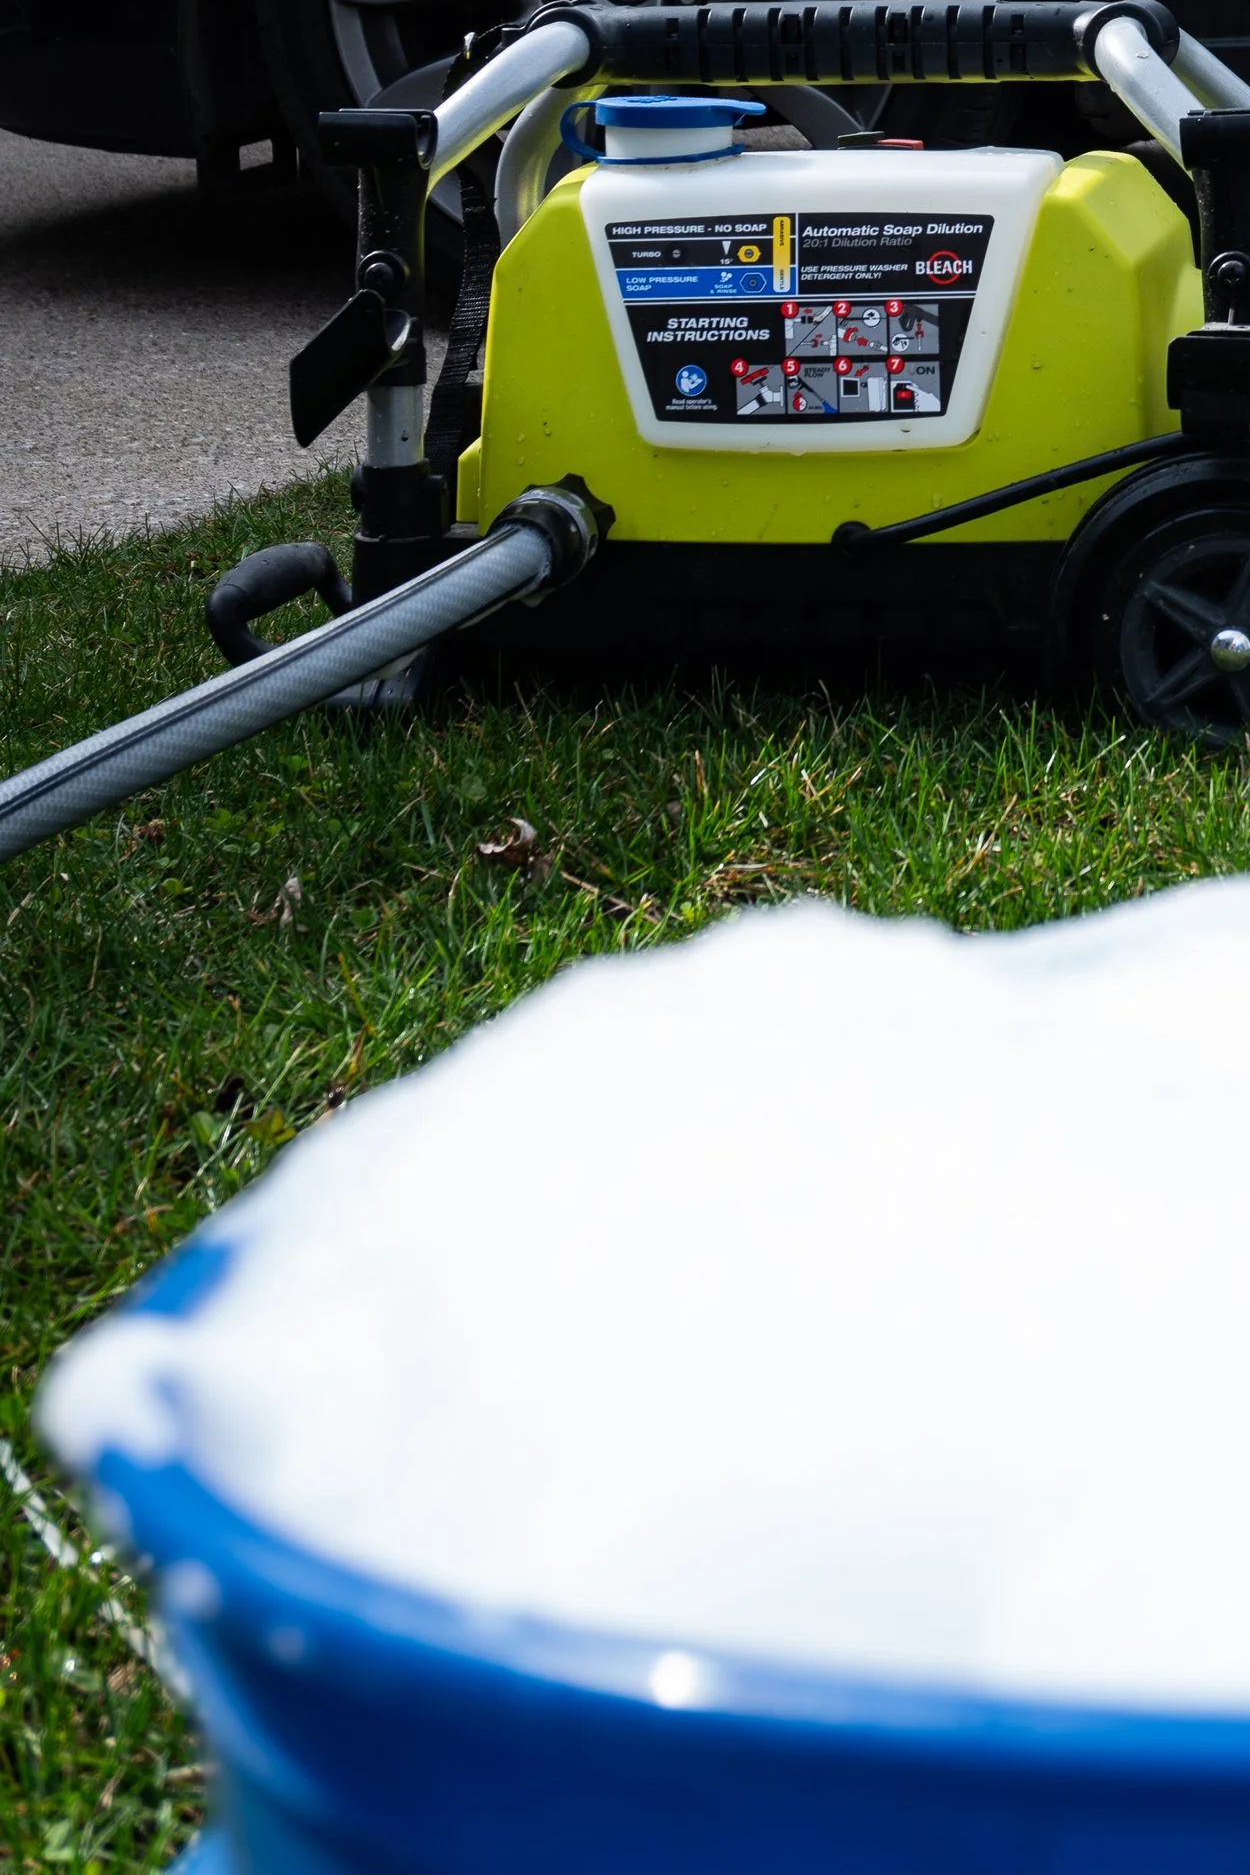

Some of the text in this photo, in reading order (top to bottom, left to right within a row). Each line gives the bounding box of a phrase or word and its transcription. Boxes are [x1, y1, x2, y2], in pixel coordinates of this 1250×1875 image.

[612, 226, 641, 235] HIGH
[644, 225, 705, 234] PRESSURE
[715, 224, 732, 233] NO
[735, 223, 767, 232] SOAP
[802, 222, 983, 237] Automatic Soap Dilution
[802, 236, 913, 248] 20:1 Dilution Ratio
[801, 263, 908, 273] USE PRESSURE WASHER
[915, 260, 973, 275] BLEACH
[626, 276, 647, 284] LOW
[801, 272, 882, 281] DETERGENT ONLY!
[626, 284, 652, 292] SOAP
[786, 304, 793, 315] 1
[837, 304, 847, 314] 2
[889, 302, 899, 312] 3
[667, 317, 749, 329] STARTING
[646, 329, 770, 342] INSTRUCTIONS
[734, 362, 744, 372] 4
[786, 361, 796, 372] 5
[838, 360, 847, 371] 6
[891, 359, 900, 369] 7
[916, 366, 935, 375] ON
